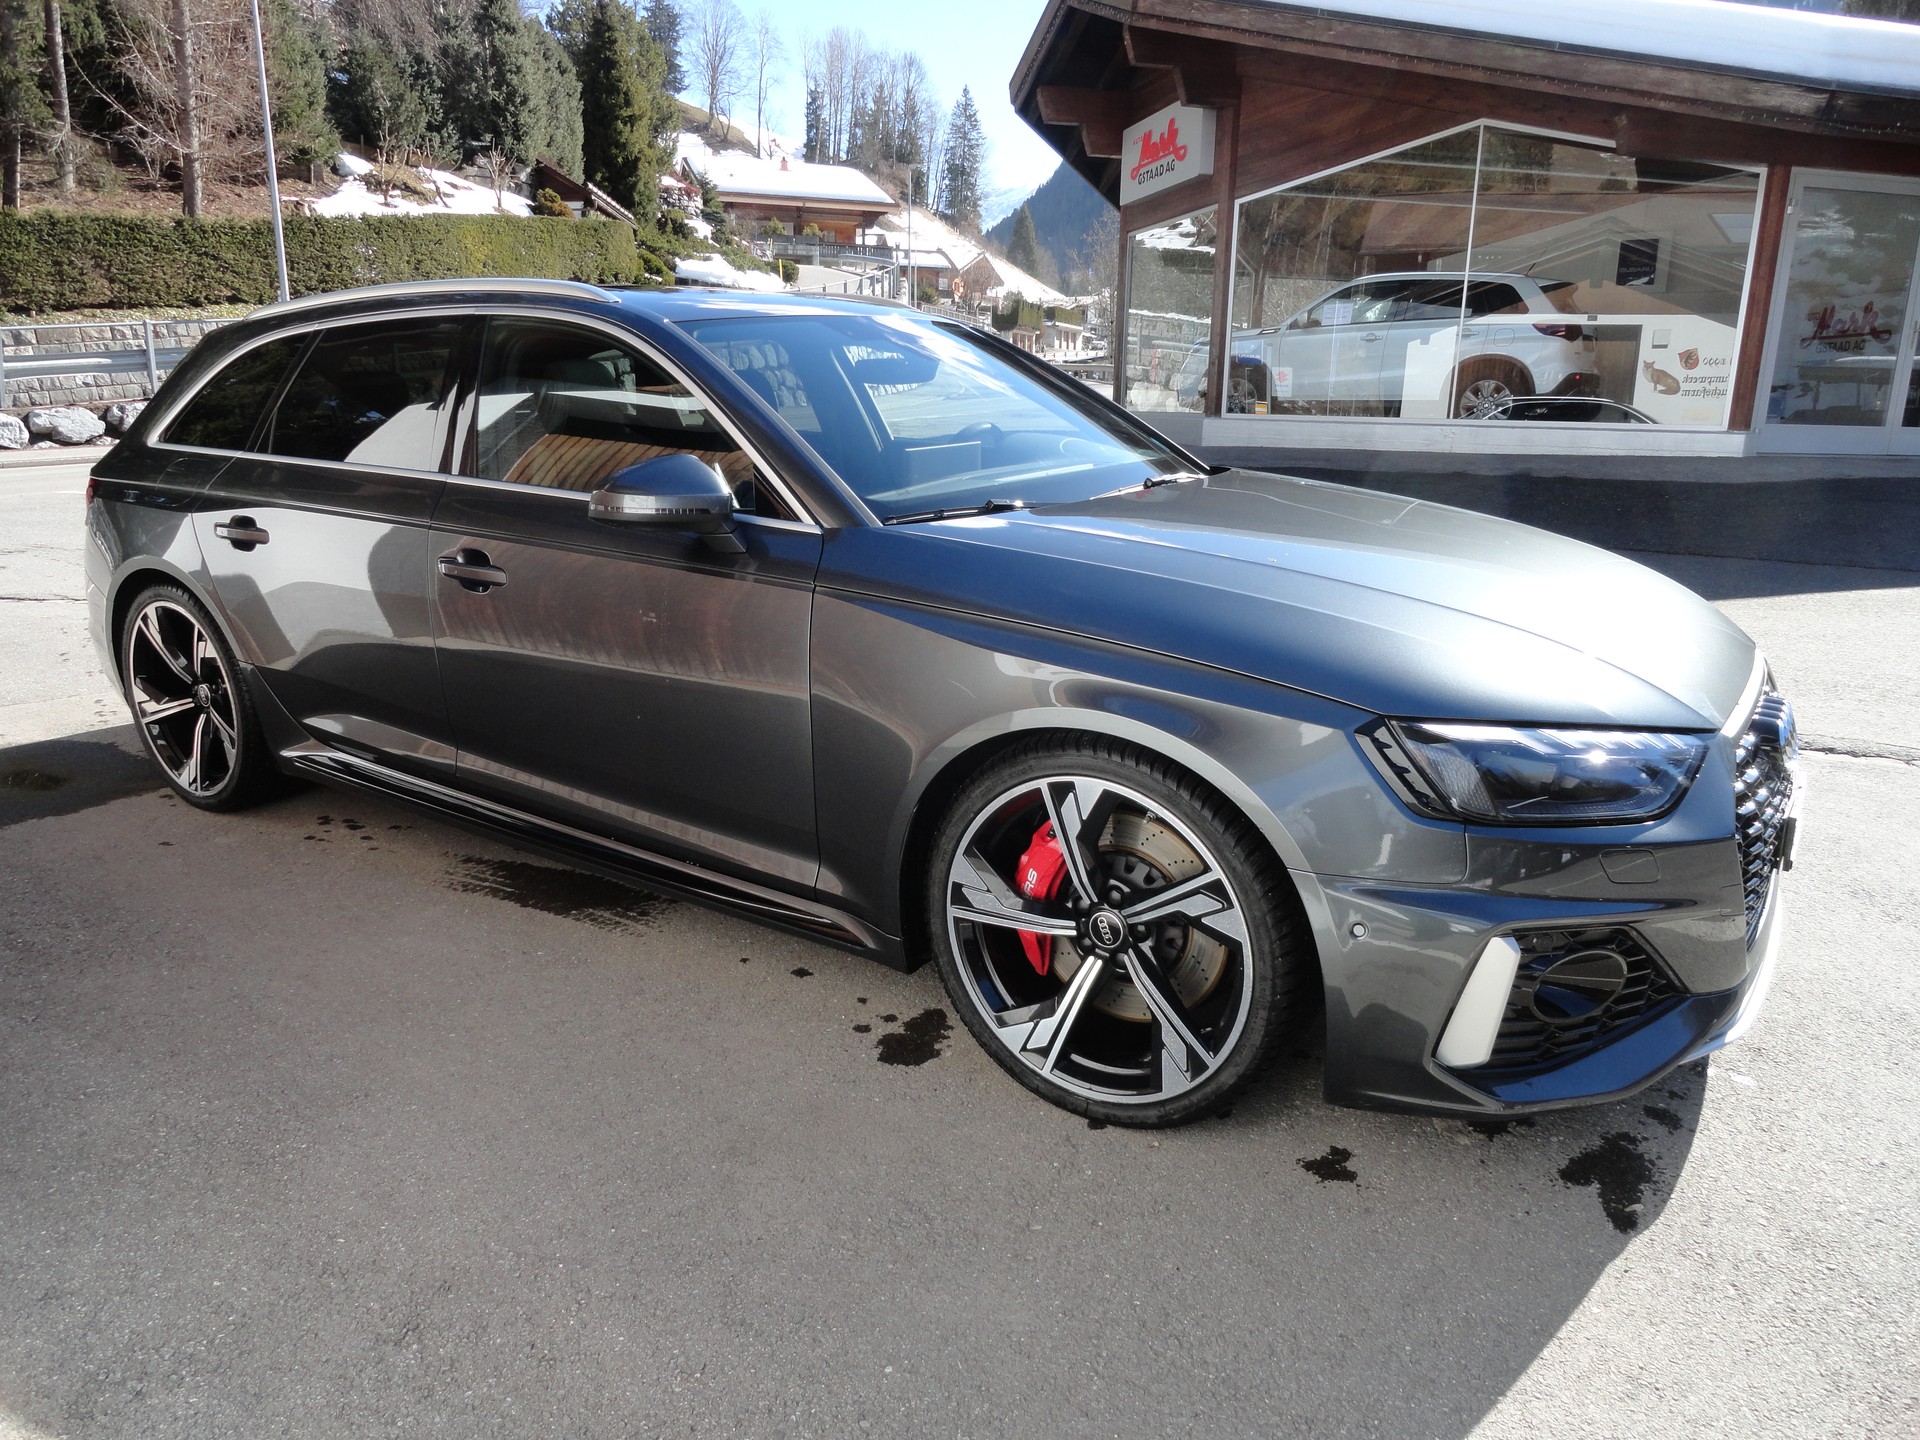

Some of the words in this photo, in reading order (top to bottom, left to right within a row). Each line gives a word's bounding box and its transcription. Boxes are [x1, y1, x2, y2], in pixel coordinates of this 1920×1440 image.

[1138, 164, 1164, 184] GSTAAD
[1166, 159, 1175, 171] AG
[1816, 342, 1850, 353] GSTAAD
[1852, 339, 1866, 351] AG
[1024, 868, 1038, 896] RS
